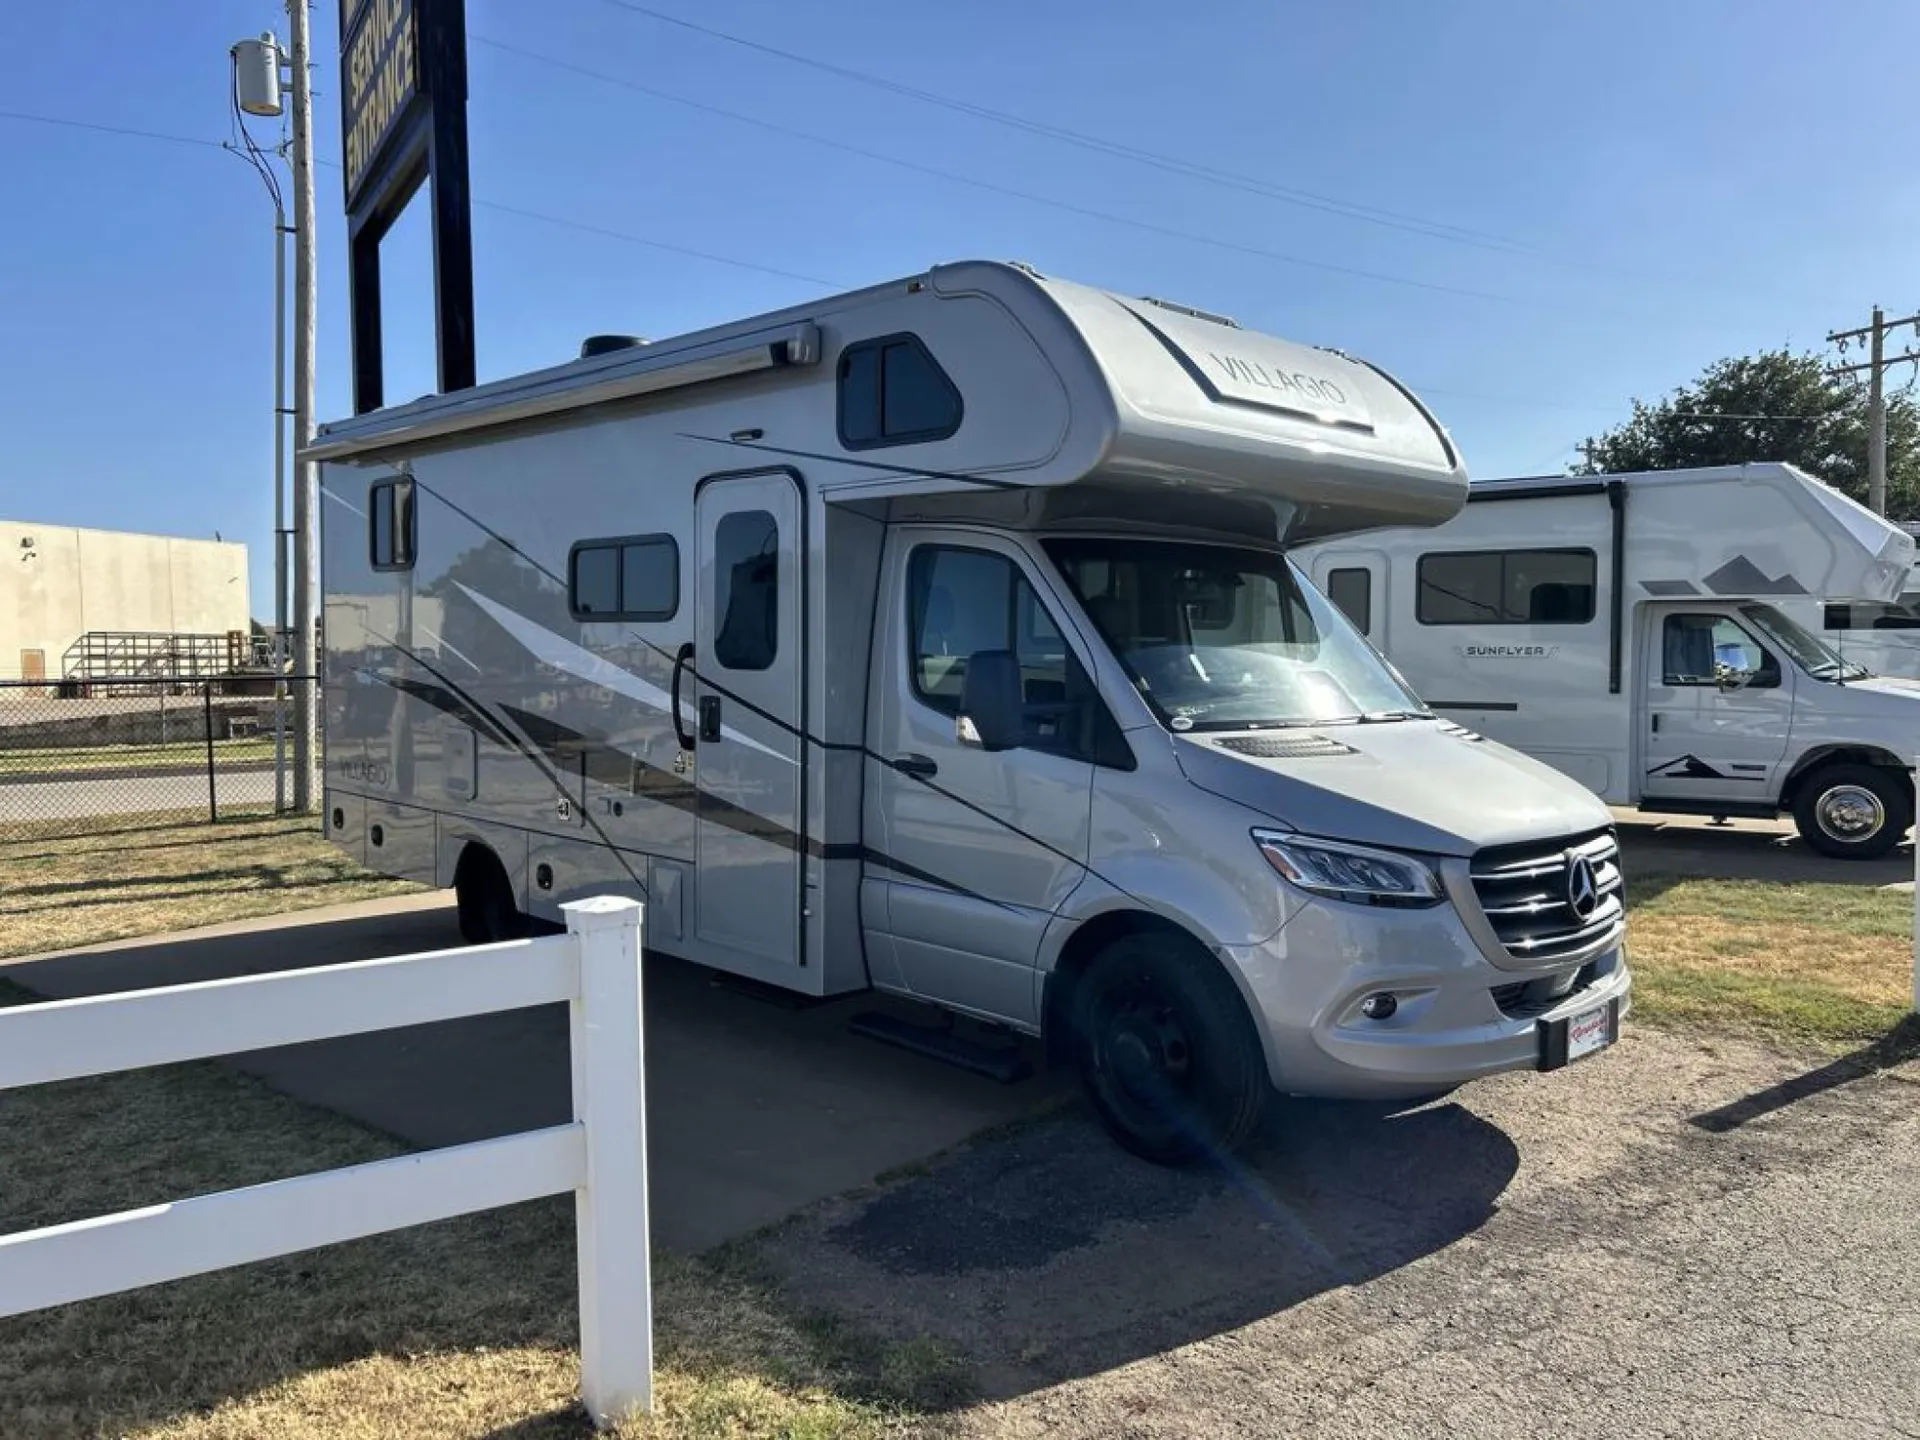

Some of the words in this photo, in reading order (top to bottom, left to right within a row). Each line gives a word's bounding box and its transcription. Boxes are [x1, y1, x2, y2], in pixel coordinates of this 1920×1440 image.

[346, 13, 414, 195] ENTRANCE
[1209, 351, 1347, 404] VILLAGIO
[1467, 646, 1544, 655] SUNFLYER
